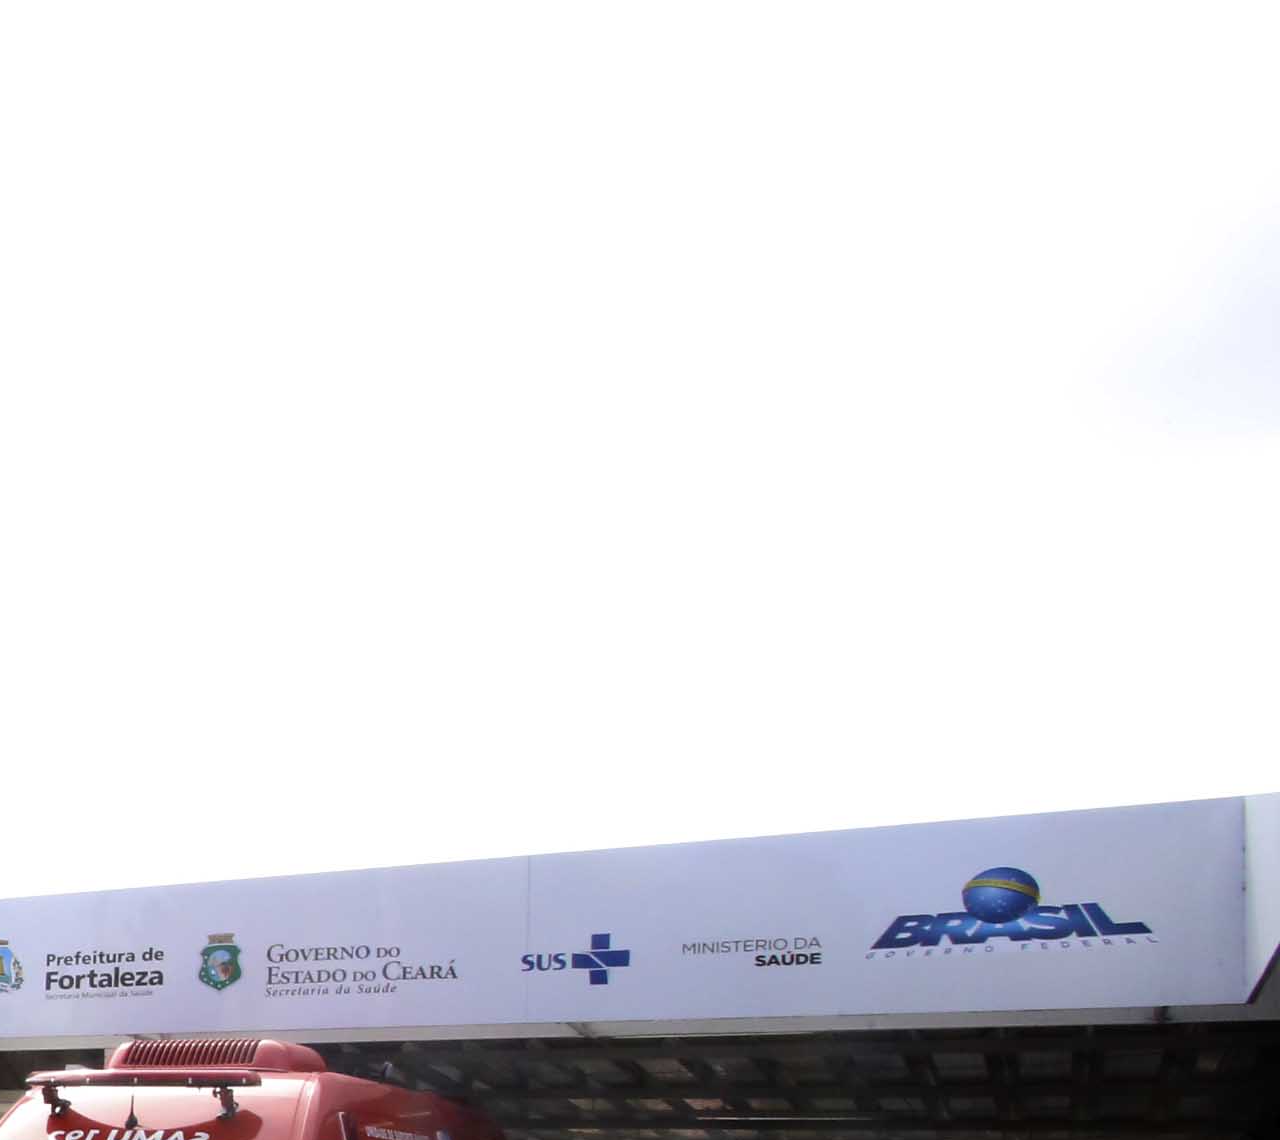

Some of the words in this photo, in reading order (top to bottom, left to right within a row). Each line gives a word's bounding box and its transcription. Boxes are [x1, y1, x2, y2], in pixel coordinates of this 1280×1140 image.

[870, 902, 1153, 950] BRASIL
[794, 936, 822, 950] DA
[865, 944, 996, 960] GOVERNO
[1020, 935, 1160, 951] FEDERAL
[46, 950, 136, 967] Prefeitura
[142, 947, 164, 961] de
[266, 944, 371, 964] GOVERNO
[376, 946, 401, 958] DO
[521, 952, 567, 971] SUS
[754, 950, 823, 967] SAÚDE
[45, 967, 164, 991] Fortaleza
[266, 965, 347, 986] ESTADO
[352, 970, 376, 983] DO
[382, 960, 458, 982] CEARÁ
[265, 986, 330, 998] Secretaria
[335, 984, 351, 996] da
[357, 982, 399, 995] Saúde
